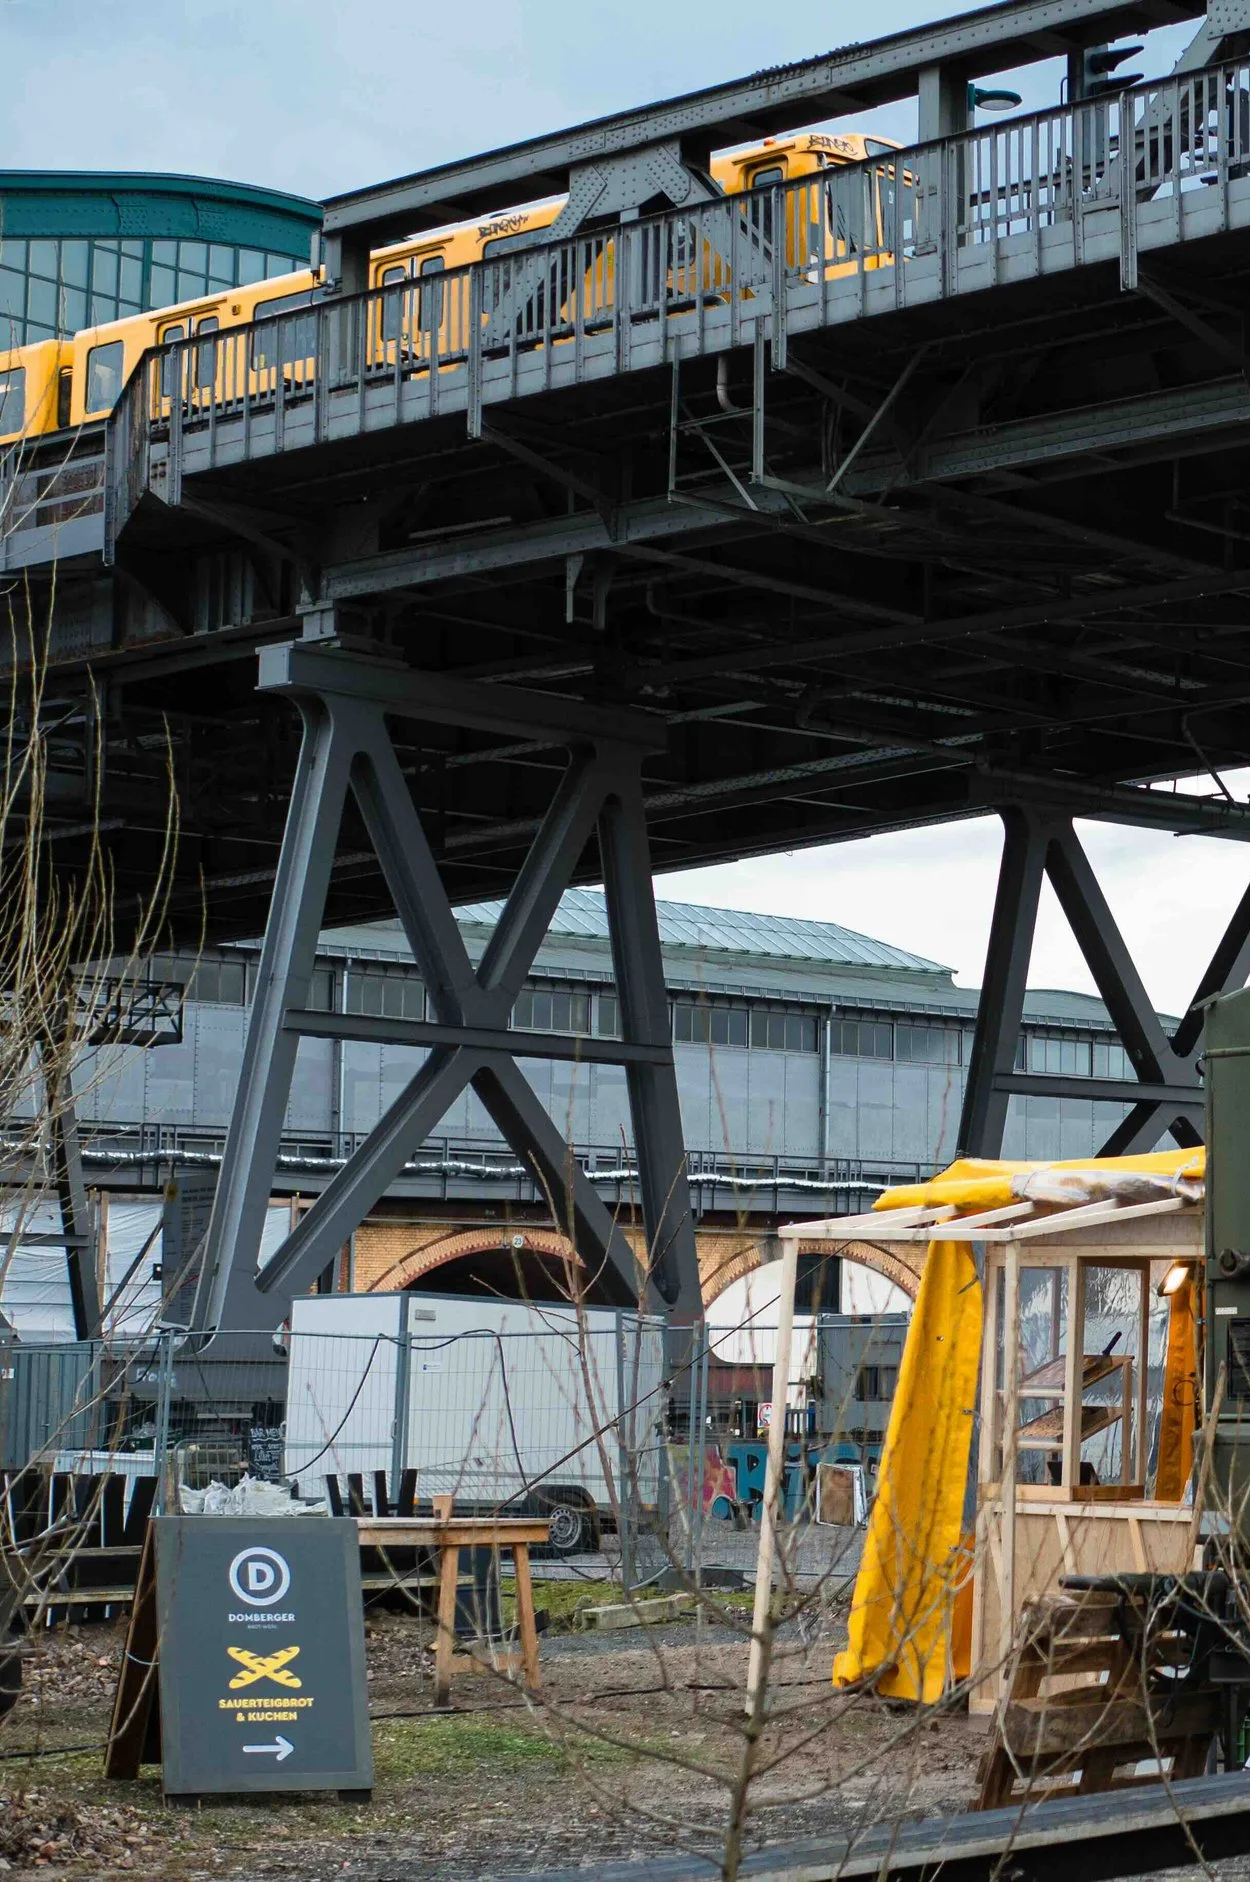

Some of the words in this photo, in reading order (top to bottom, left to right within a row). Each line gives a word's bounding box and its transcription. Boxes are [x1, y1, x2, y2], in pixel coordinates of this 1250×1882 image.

[228, 1613, 296, 1622] DOMBERGER
[219, 1698, 314, 1709] SAUERTEIGBROT
[236, 1712, 245, 1722] &
[248, 1711, 298, 1721] KUCHEN
